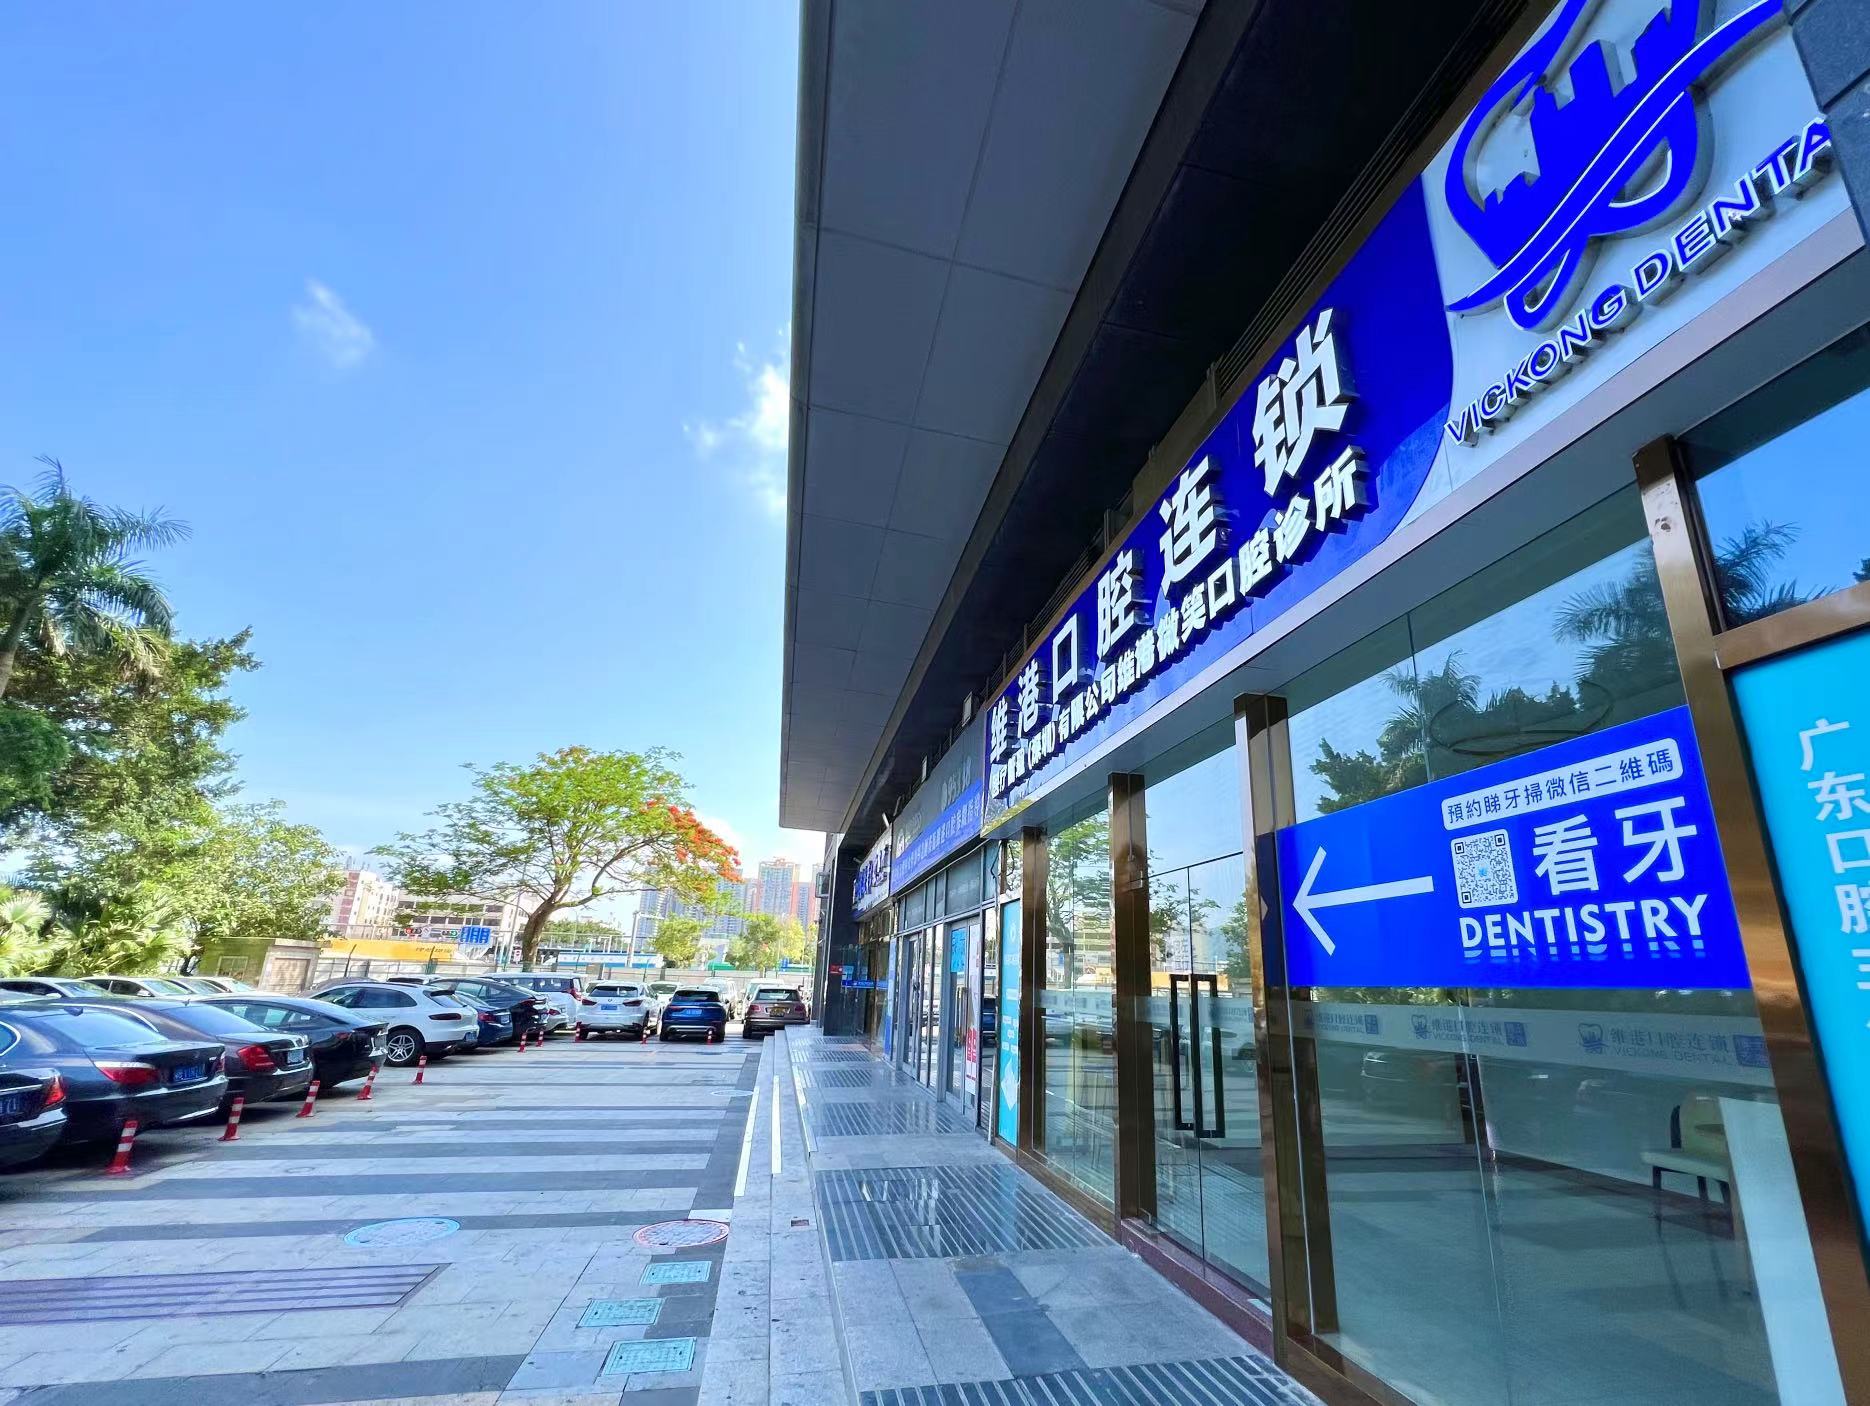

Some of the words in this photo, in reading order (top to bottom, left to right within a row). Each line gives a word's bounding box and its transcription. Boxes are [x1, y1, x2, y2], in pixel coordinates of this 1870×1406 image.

[1444, 284, 1628, 446] VICKONG
[990, 308, 1349, 764] 维港口腔连锁
[1448, 748, 1674, 824] 預約睇牙掃微信二維碼
[1533, 796, 1698, 895] 看牙
[1459, 894, 1708, 948] DENTISTRY
